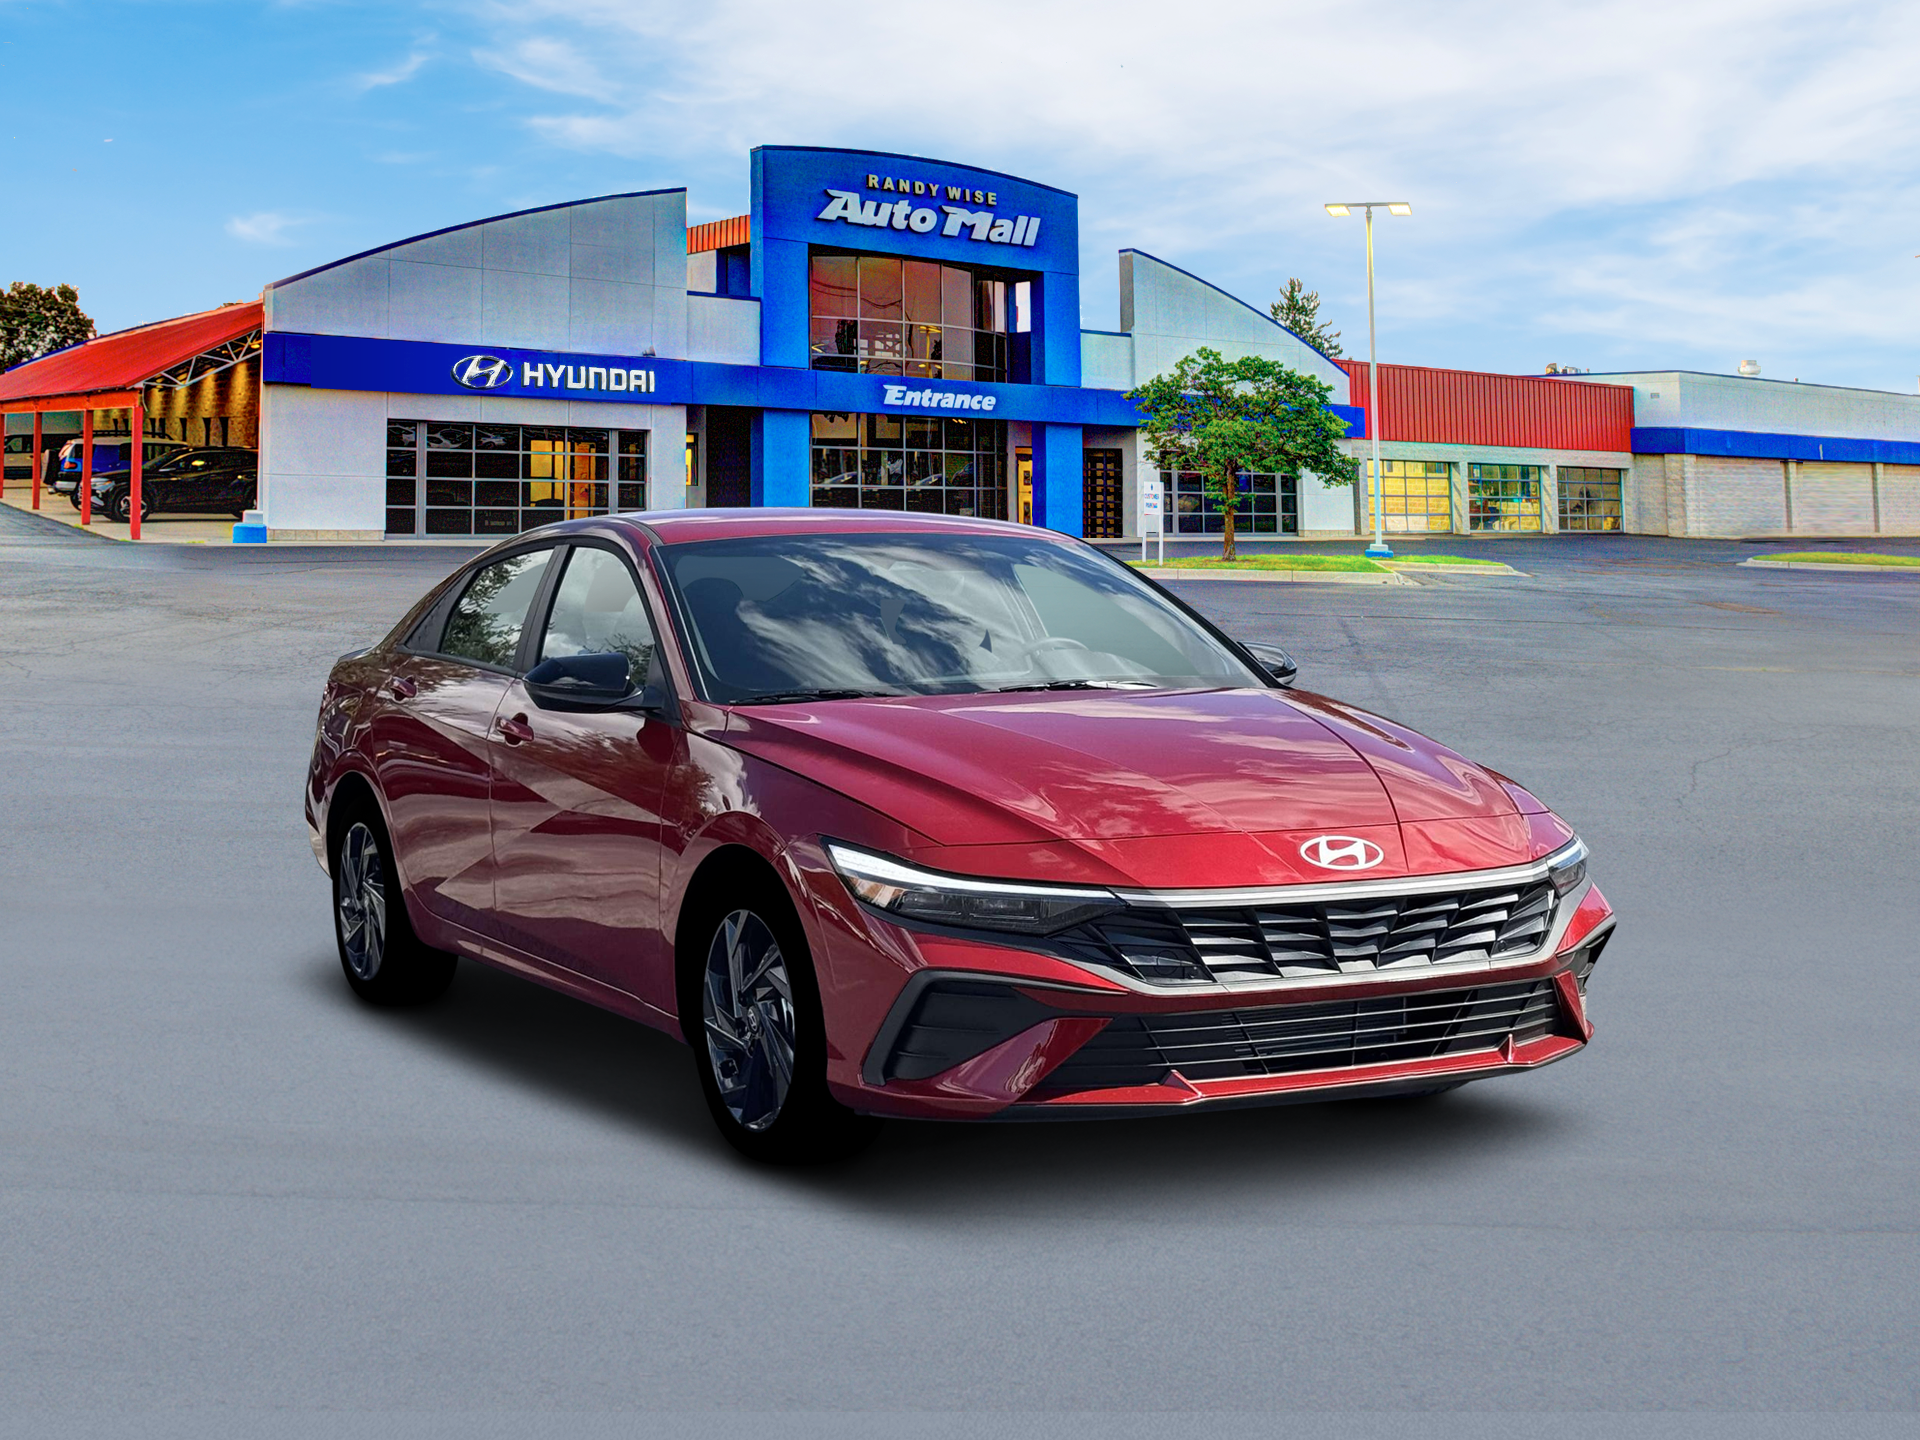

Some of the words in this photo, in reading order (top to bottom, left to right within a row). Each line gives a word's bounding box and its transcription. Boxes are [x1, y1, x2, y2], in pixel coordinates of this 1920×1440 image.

[866, 174, 939, 197] RANDY
[946, 187, 998, 206] WISE
[816, 189, 938, 233] Auto
[938, 206, 1041, 247] Mall
[522, 361, 655, 393] HYUNDAI
[883, 384, 996, 411] Entrance
